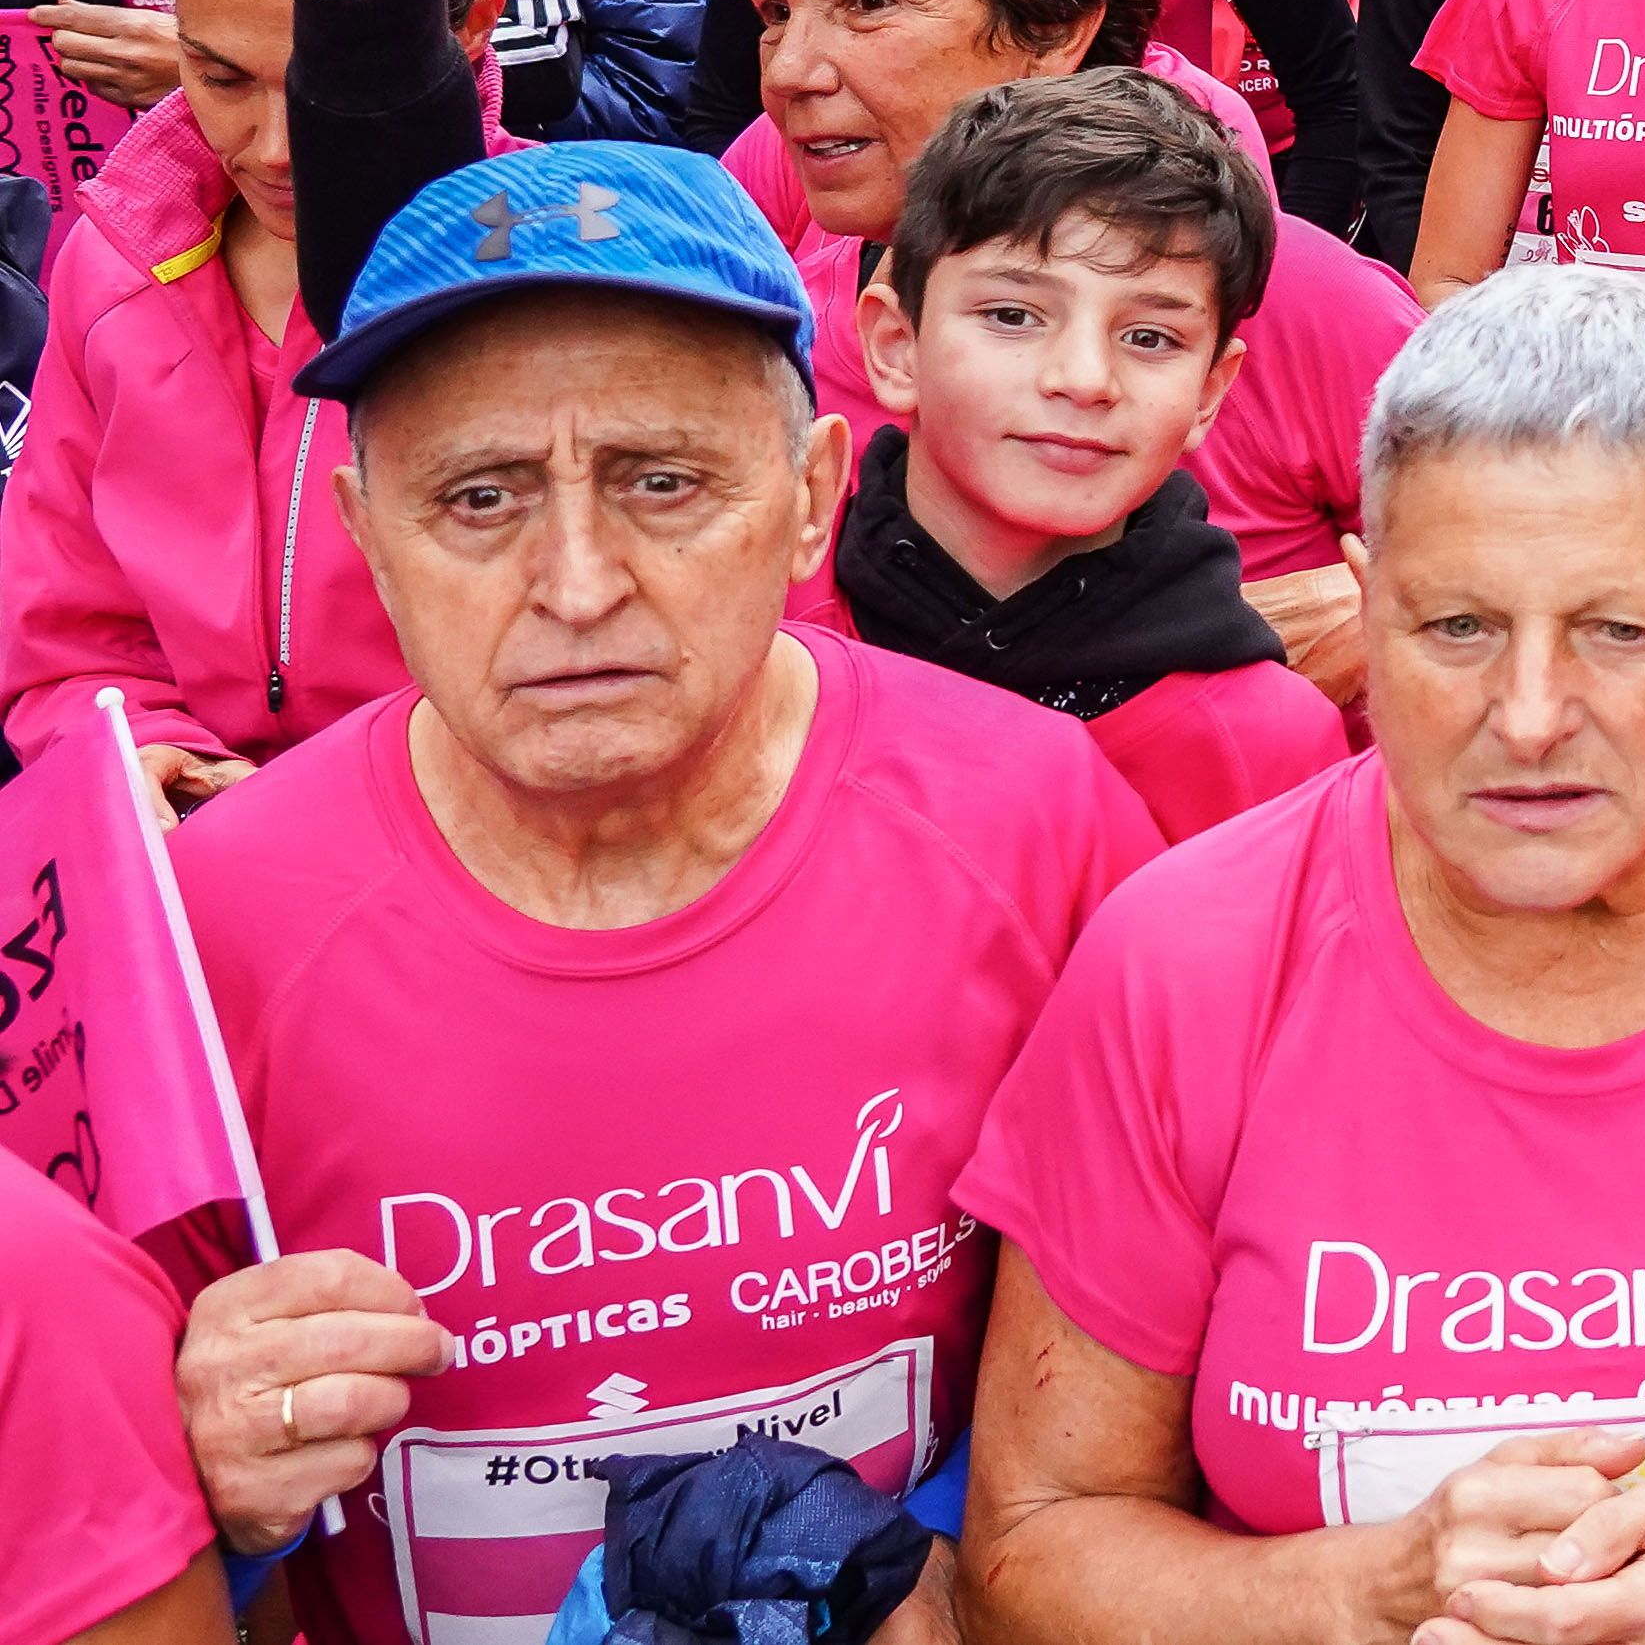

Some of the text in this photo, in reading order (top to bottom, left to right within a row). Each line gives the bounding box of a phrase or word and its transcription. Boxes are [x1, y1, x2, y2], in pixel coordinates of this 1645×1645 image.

[380, 1088, 904, 1298] Drasanvi
[730, 1210, 977, 1315] CAROBELS
[761, 1255, 952, 1331] hair beauty style
